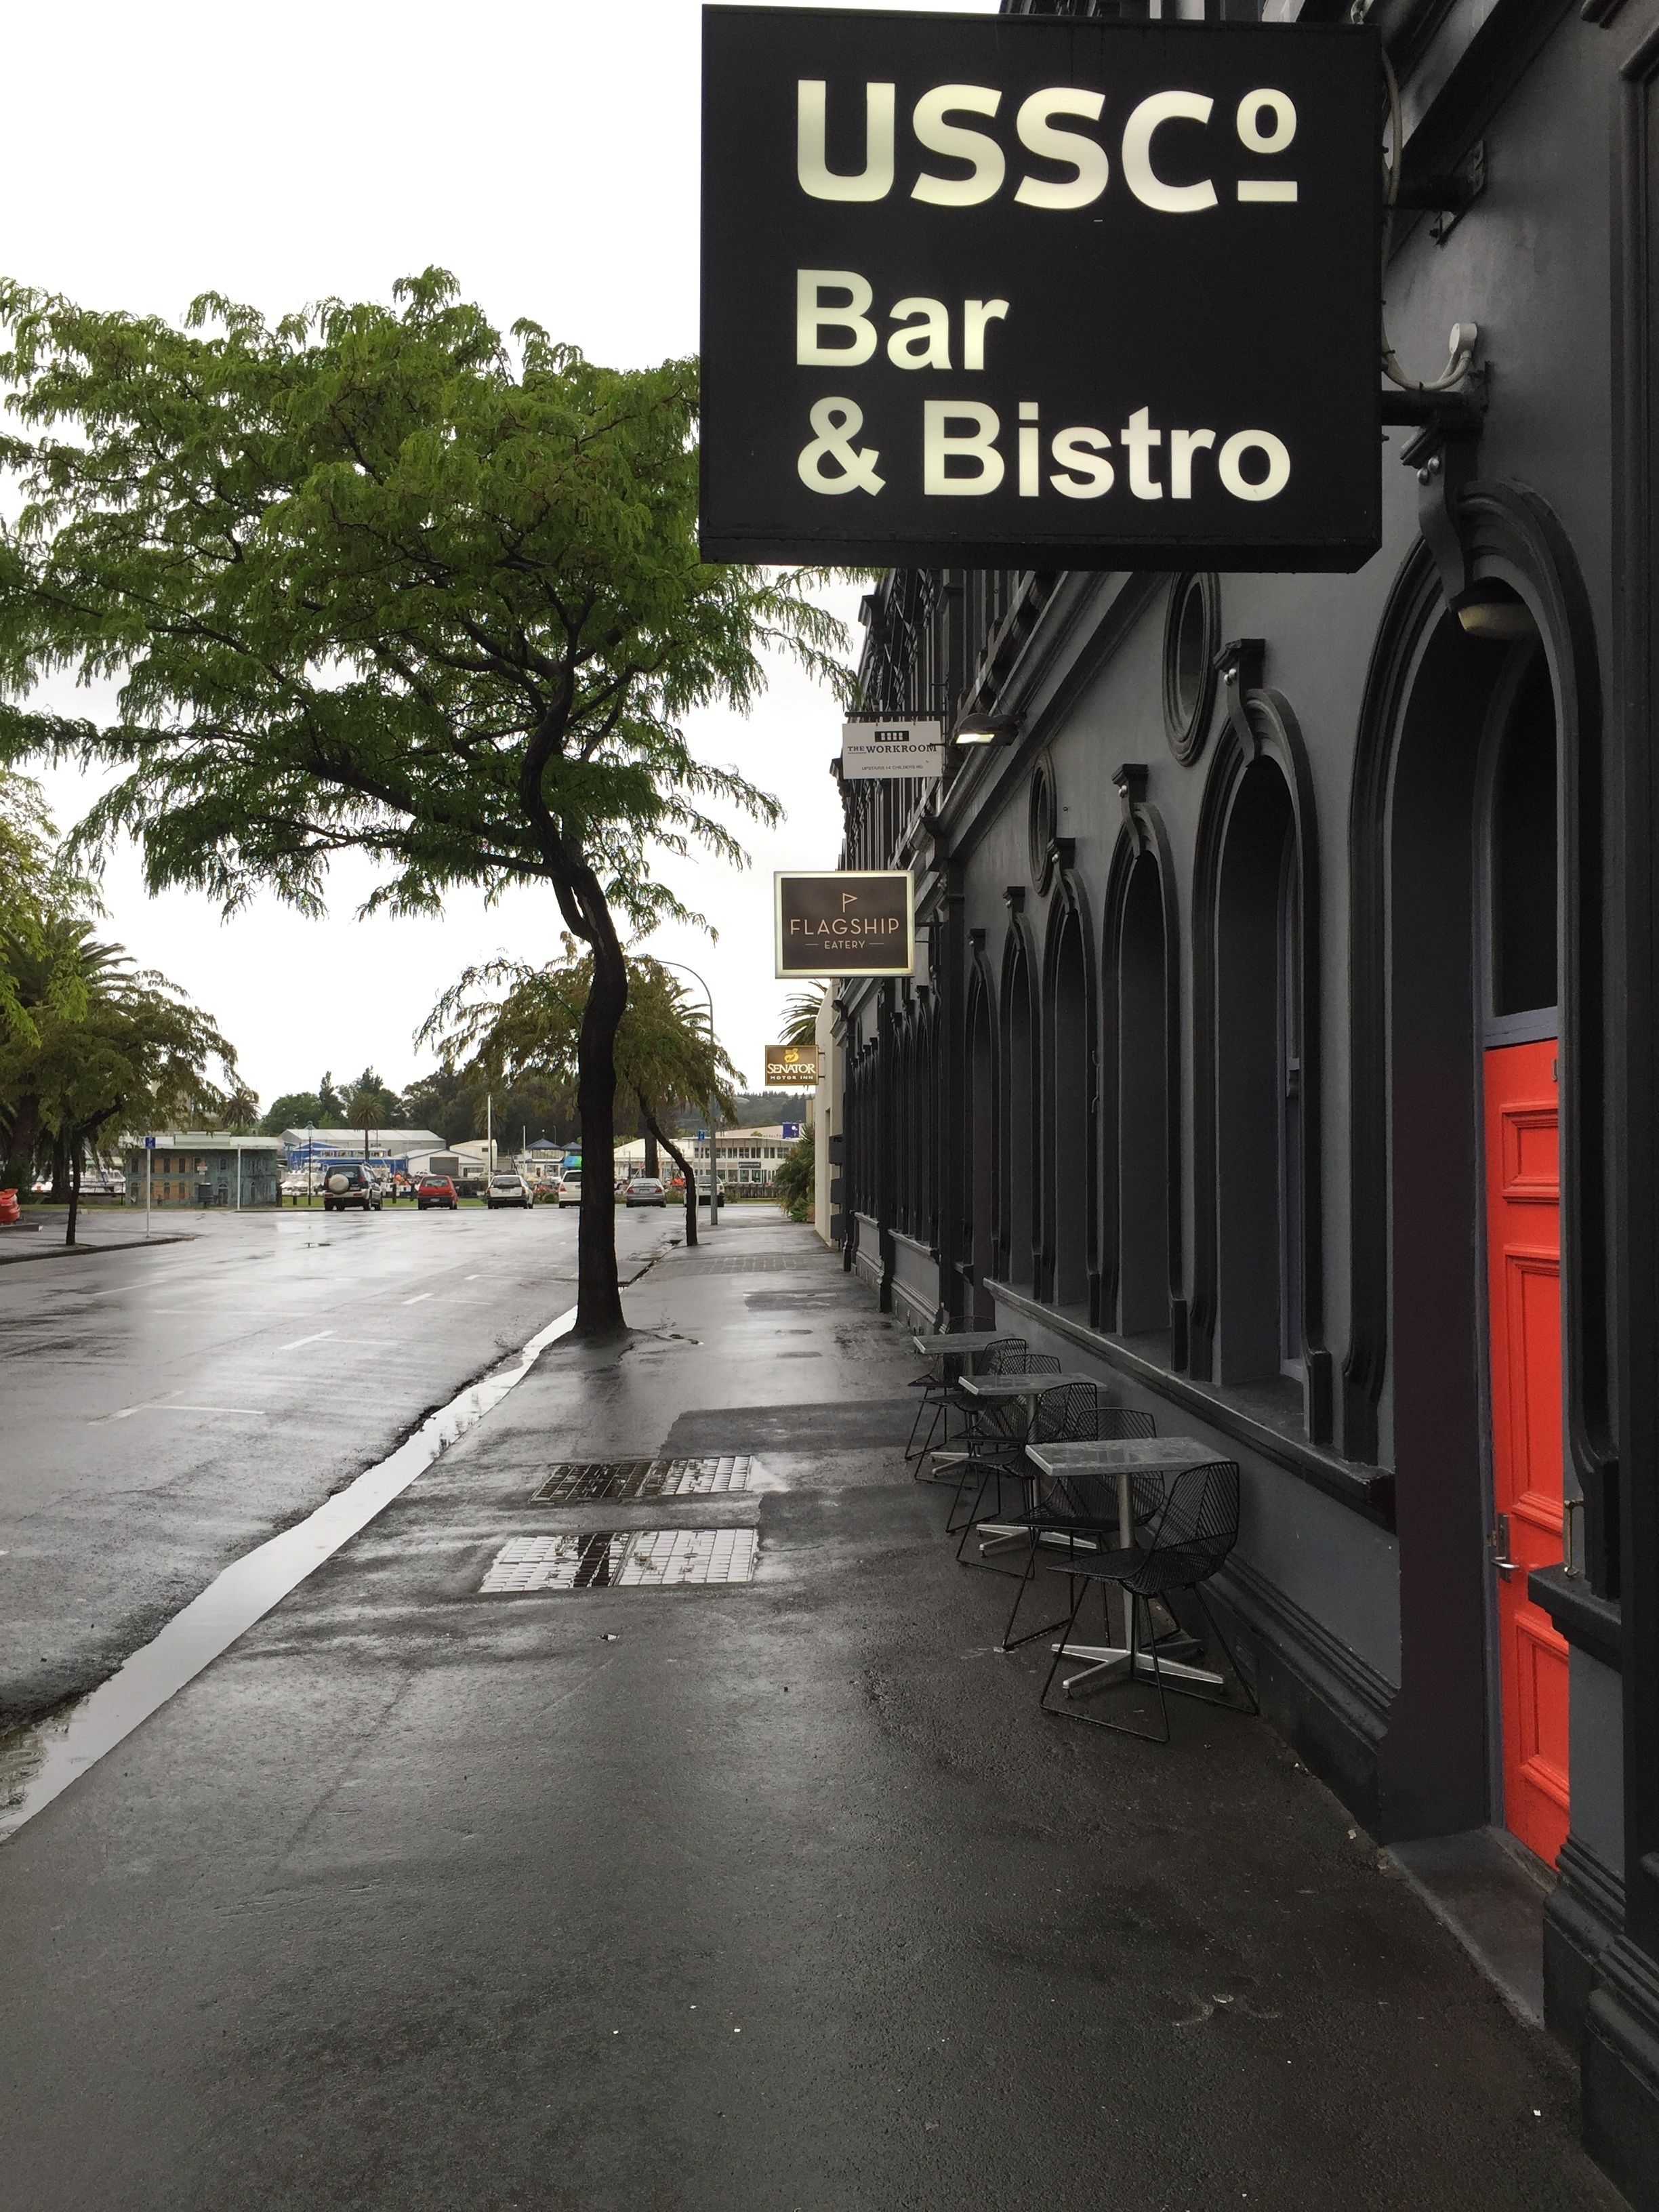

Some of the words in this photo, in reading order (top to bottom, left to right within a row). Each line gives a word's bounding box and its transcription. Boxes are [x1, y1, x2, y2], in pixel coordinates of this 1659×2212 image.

[796, 269, 1010, 370] Bar
[797, 396, 886, 497] &
[924, 400, 1291, 501] Bistro
[866, 745, 937, 754] WORKROOM
[790, 918, 899, 935] FLAGSHIP
[824, 941, 865, 949] EATERY
[766, 1063, 816, 1074] SENATOR
